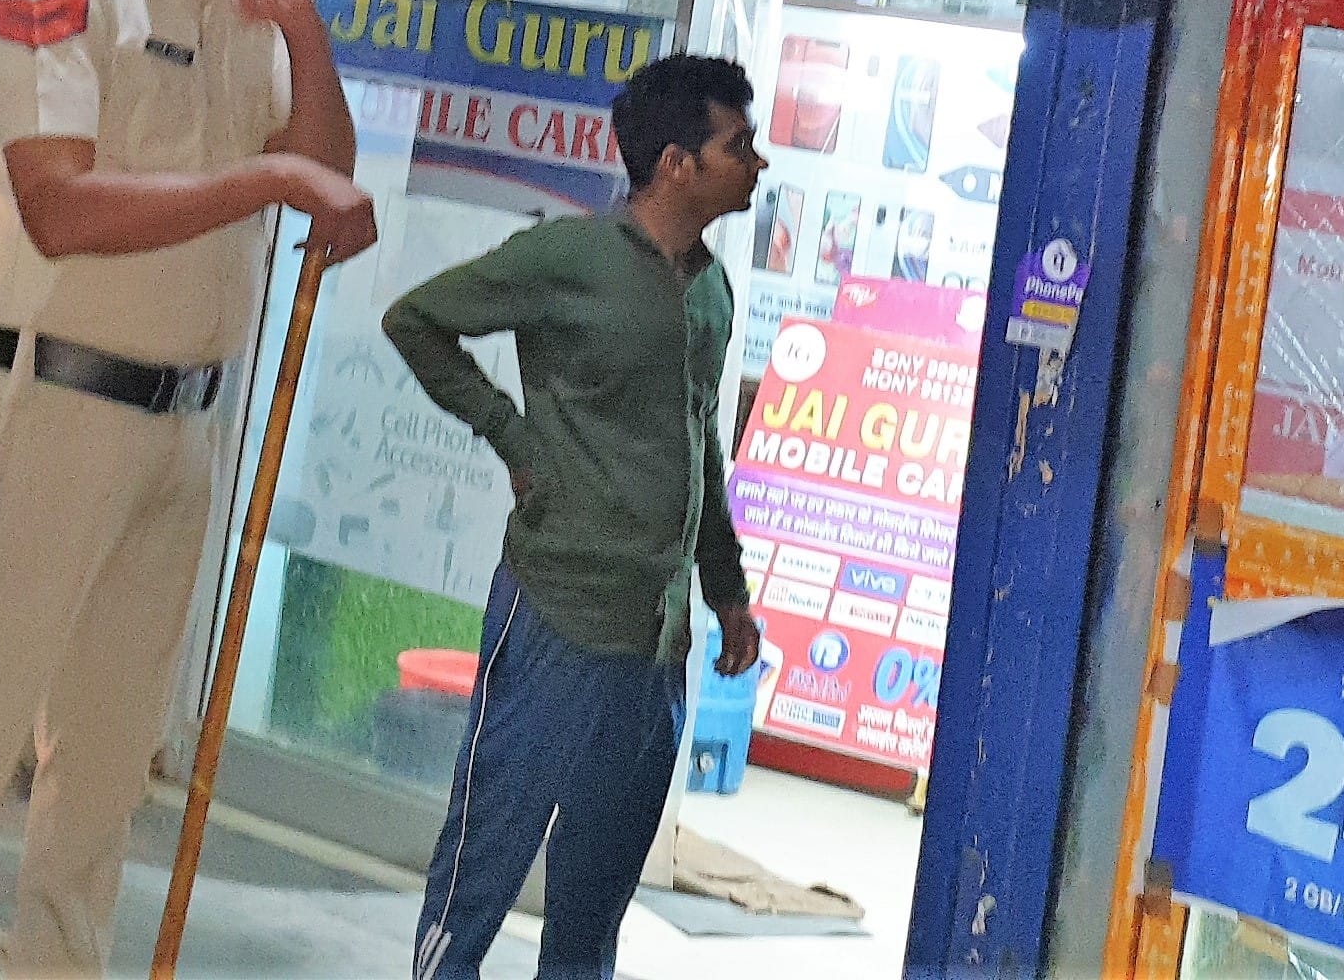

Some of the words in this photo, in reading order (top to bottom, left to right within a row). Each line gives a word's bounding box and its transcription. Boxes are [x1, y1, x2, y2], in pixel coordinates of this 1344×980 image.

[763, 383, 849, 441] JAI
[746, 429, 890, 489] MOBILE
[850, 569, 897, 596] vivo
